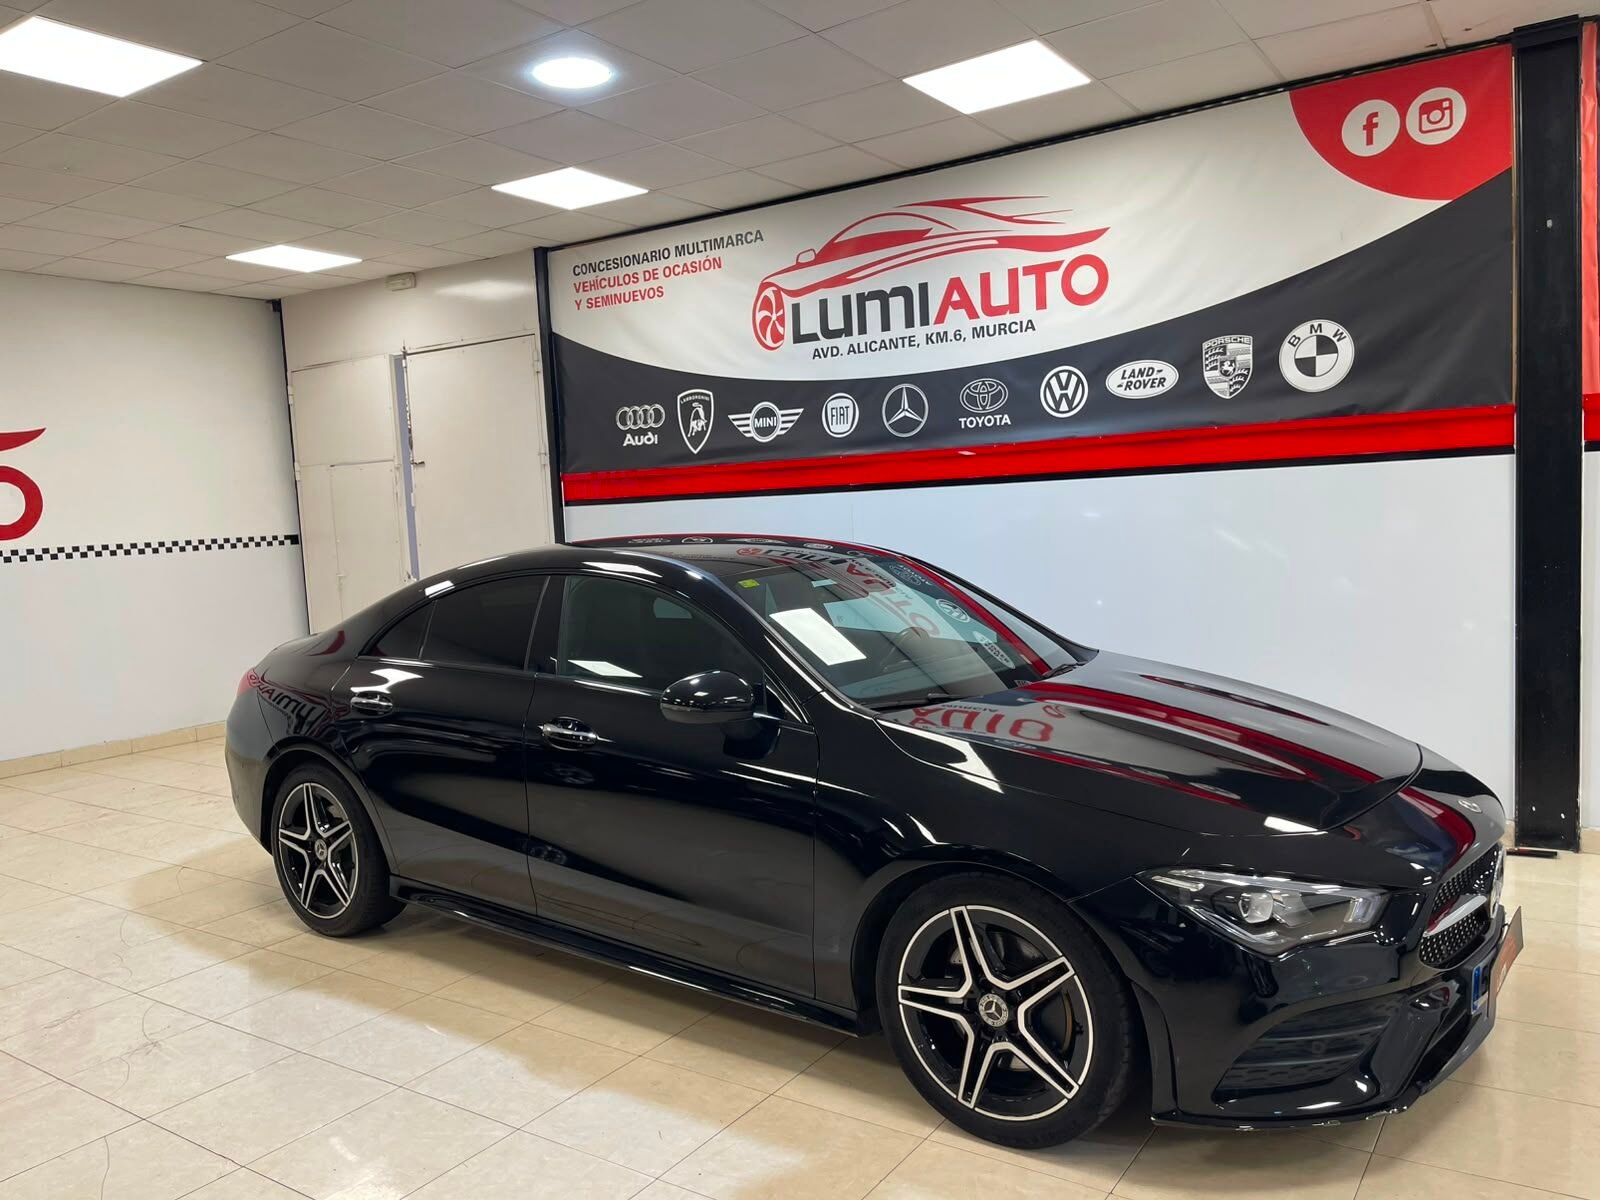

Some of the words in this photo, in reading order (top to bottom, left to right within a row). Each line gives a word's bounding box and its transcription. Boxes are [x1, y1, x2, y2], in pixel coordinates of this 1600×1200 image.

[573, 248, 671, 276] CONCESIONARIO
[675, 229, 764, 257] MULTIMARCA
[573, 272, 640, 293] VEHÍCULOS
[643, 268, 659, 282] DE
[663, 255, 722, 278] OCASIÓN
[575, 299, 582, 310] Y
[586, 286, 664, 310] SEMINUEVOS
[812, 343, 843, 360] AVD.
[847, 335, 920, 356] ALICANTE,
[925, 329, 966, 346] KM.6,
[971, 319, 1036, 339] MURCIA
[1203, 336, 1251, 349] PORSCHE
[1287, 323, 1347, 347] BMW
[754, 417, 777, 428] MINI
[830, 405, 850, 426] FIAT
[959, 415, 1011, 429] TOYOTA
[623, 432, 658, 446] Audi
